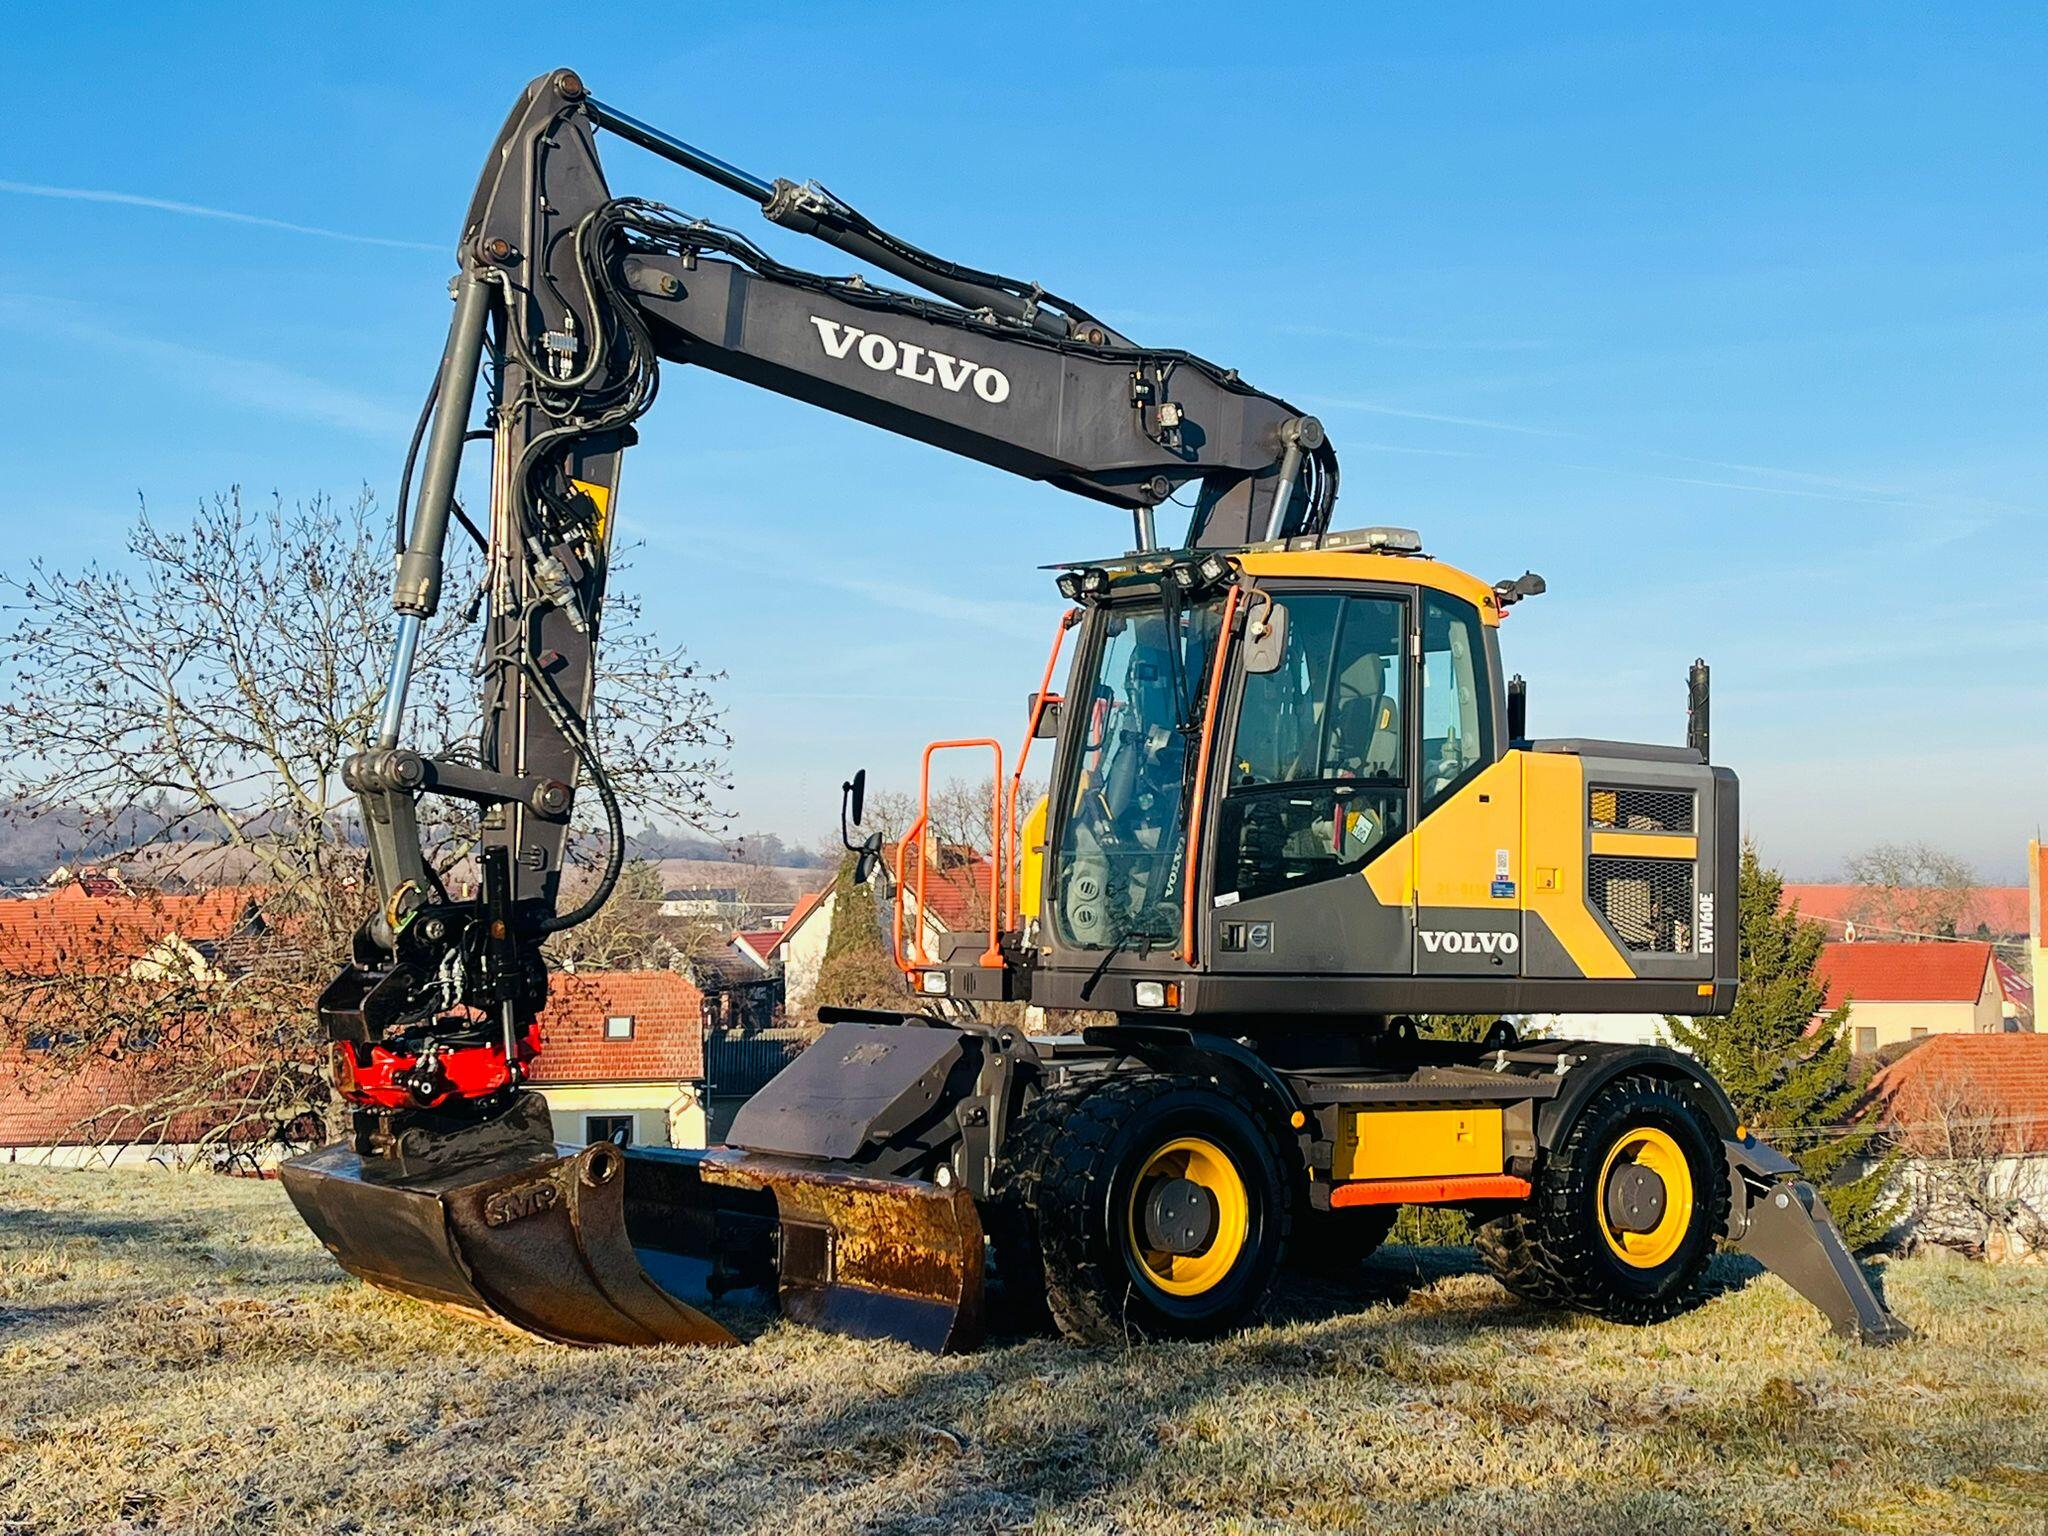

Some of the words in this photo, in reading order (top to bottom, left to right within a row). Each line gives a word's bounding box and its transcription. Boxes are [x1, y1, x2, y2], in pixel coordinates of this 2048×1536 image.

[810, 315, 1010, 404] VOLVO
[1419, 931, 1519, 954] VOLVO
[1699, 892, 1714, 954] EW160E
[485, 1182, 557, 1227] SMP
